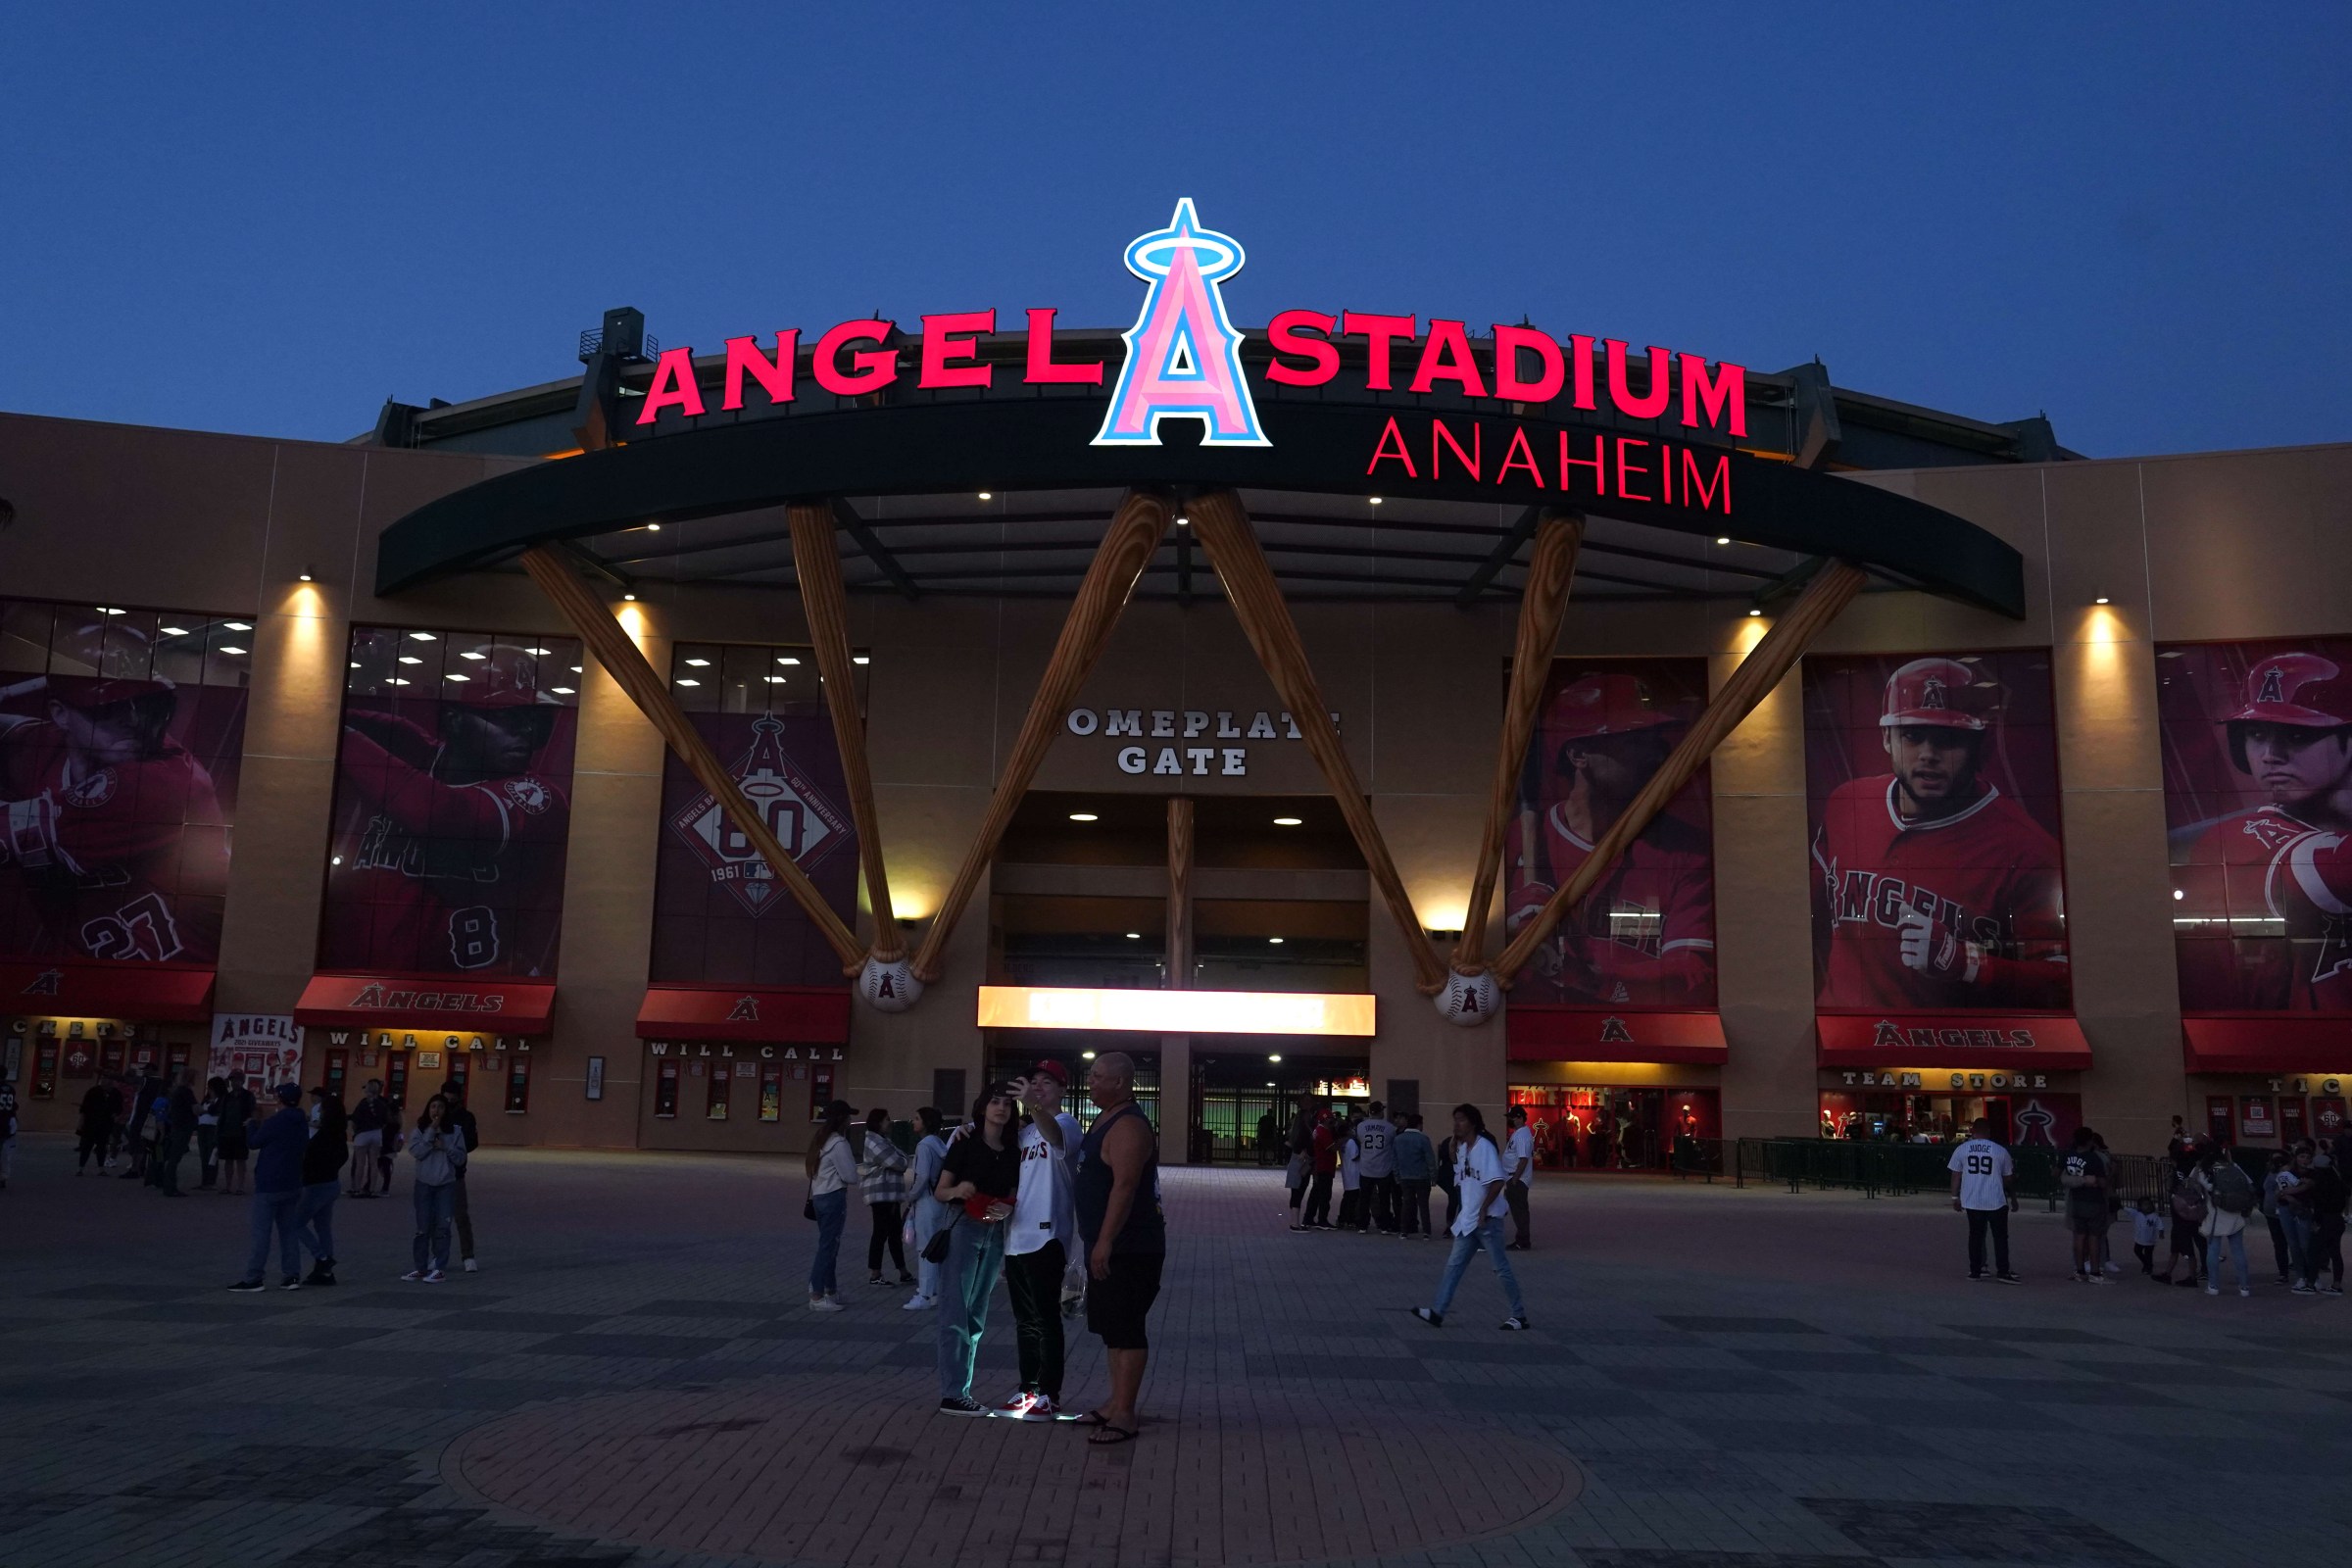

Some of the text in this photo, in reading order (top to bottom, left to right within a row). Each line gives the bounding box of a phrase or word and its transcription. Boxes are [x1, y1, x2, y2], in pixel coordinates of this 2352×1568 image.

[636, 308, 1748, 437] ANGEL STADIUM
[1367, 416, 1731, 514] ANAHEIM
[1028, 707, 1340, 739] OMEPLAT
[1117, 746, 1247, 776] GATE
[678, 804, 706, 828] ANGELS
[804, 791, 847, 835] ANNIVERSARY
[710, 865, 739, 881] 1961
[448, 906, 500, 969] 8
[348, 982, 504, 1012] ANGELS
[220, 1017, 298, 1044] ANGELS
[330, 1032, 529, 1052] WILL CALL
[1874, 1019, 2035, 1049] ANGELS
[651, 1043, 843, 1060] WILL CALL
[1842, 1072, 2047, 1089] TEAM STORE
[1364, 1135, 1385, 1150] 23
[1969, 1144, 1991, 1152] JUDGE
[1967, 1155, 1992, 1175] 99
[2066, 1156, 2087, 1168] JUDGE
